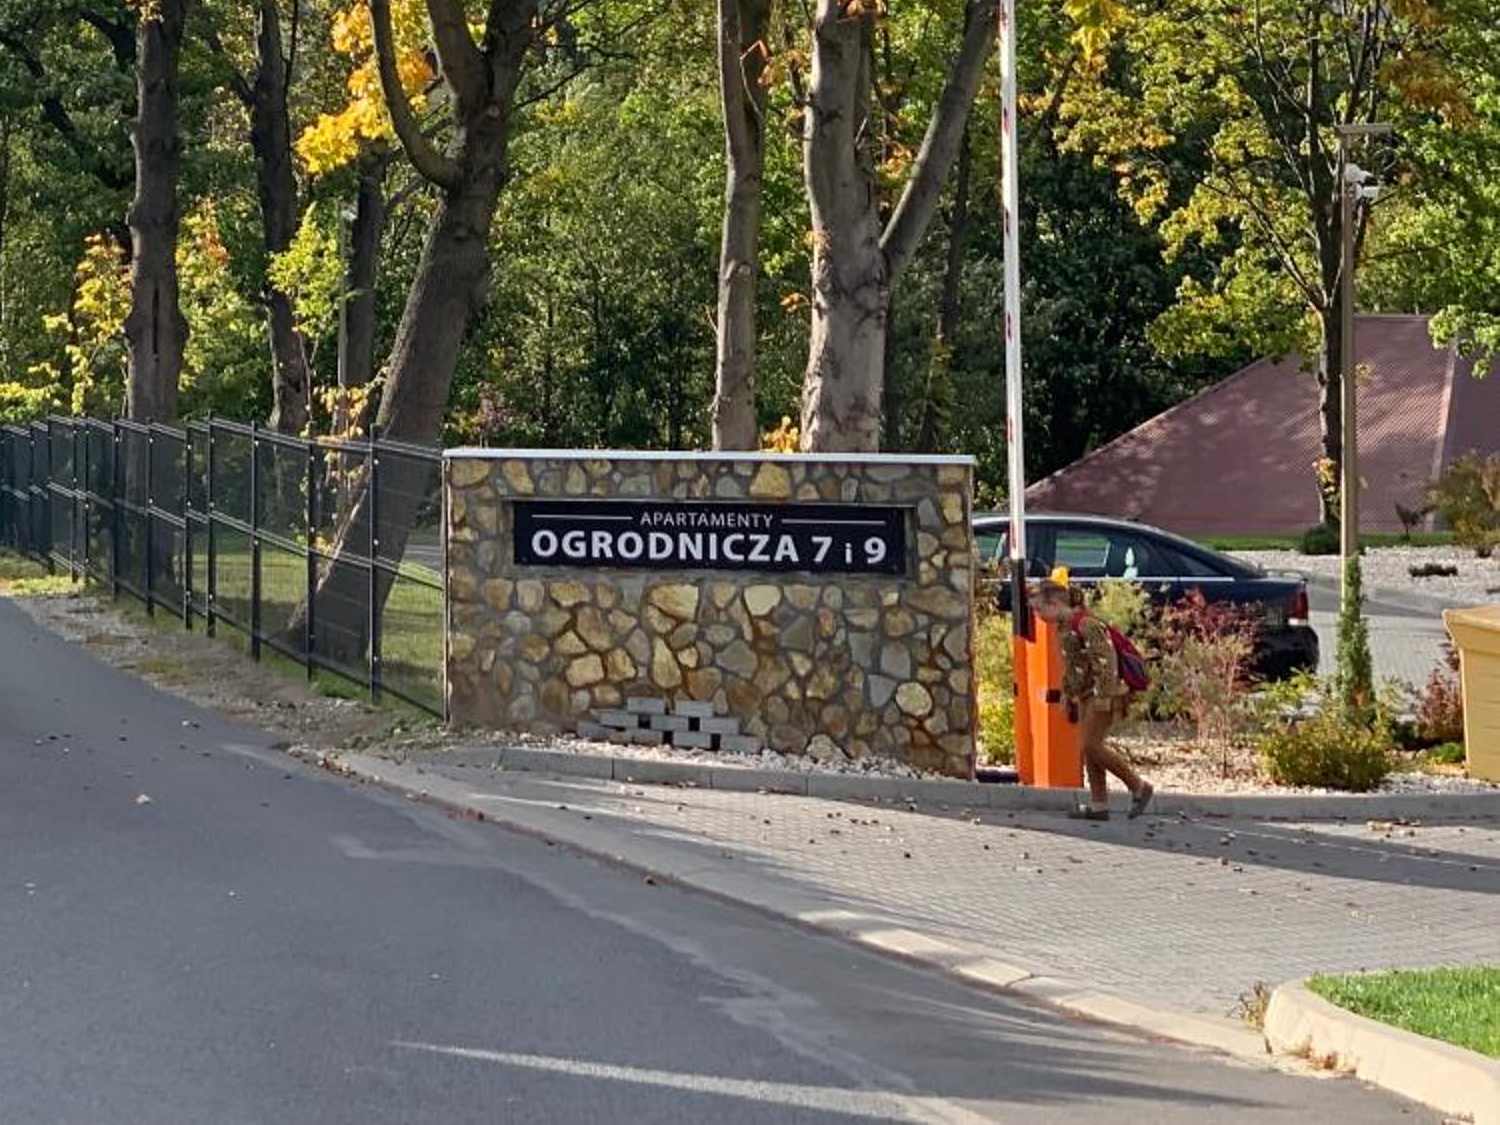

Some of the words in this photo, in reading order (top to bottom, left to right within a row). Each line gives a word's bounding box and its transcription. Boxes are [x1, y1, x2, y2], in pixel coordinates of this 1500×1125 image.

[639, 511, 773, 528] APARTAMENTY
[531, 529, 799, 563] OGRODNICZA
[811, 536, 833, 562] 7
[844, 542, 853, 563] i
[864, 536, 887, 564] 9
